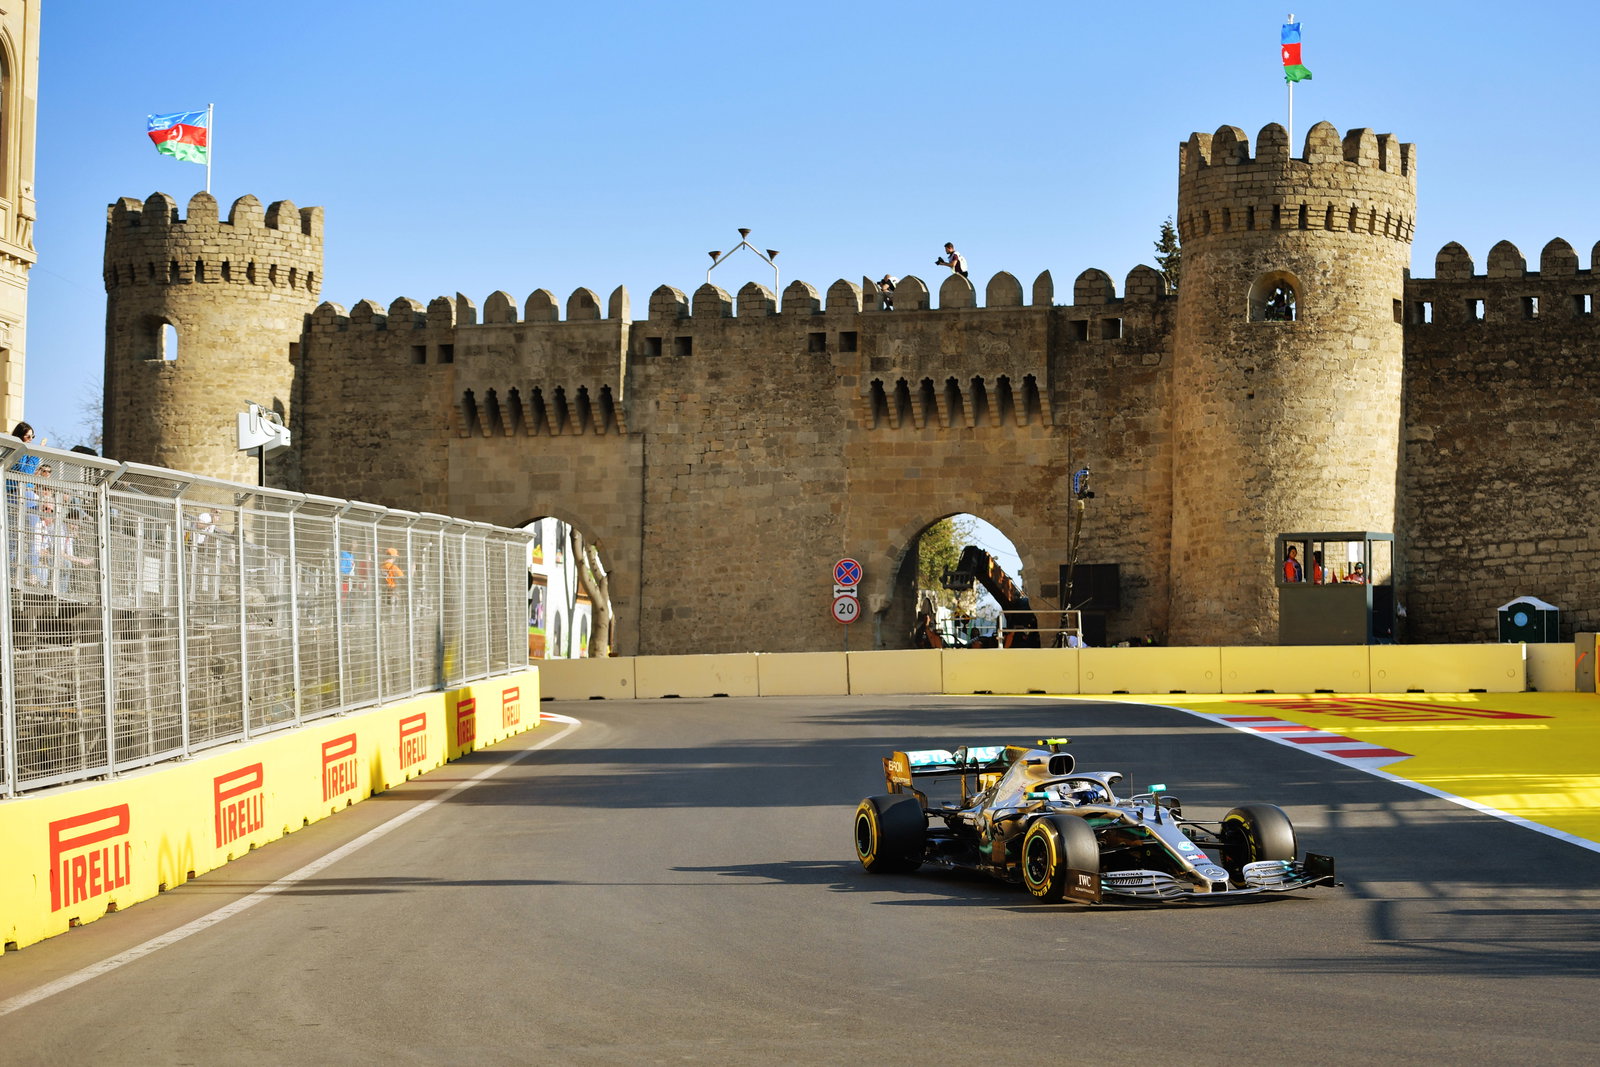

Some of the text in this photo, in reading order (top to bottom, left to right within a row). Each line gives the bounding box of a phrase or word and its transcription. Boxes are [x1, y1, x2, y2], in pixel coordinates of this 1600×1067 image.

[837, 613, 861, 628] 20
[456, 697, 476, 747] PIRELLI
[502, 686, 521, 729] PIRELLI
[322, 733, 358, 803] PIRELLI
[399, 712, 427, 770] PIRELLI
[213, 762, 264, 849] PIRELLI
[48, 803, 130, 913] PIRELLI
[1078, 874, 1092, 887] IWC
